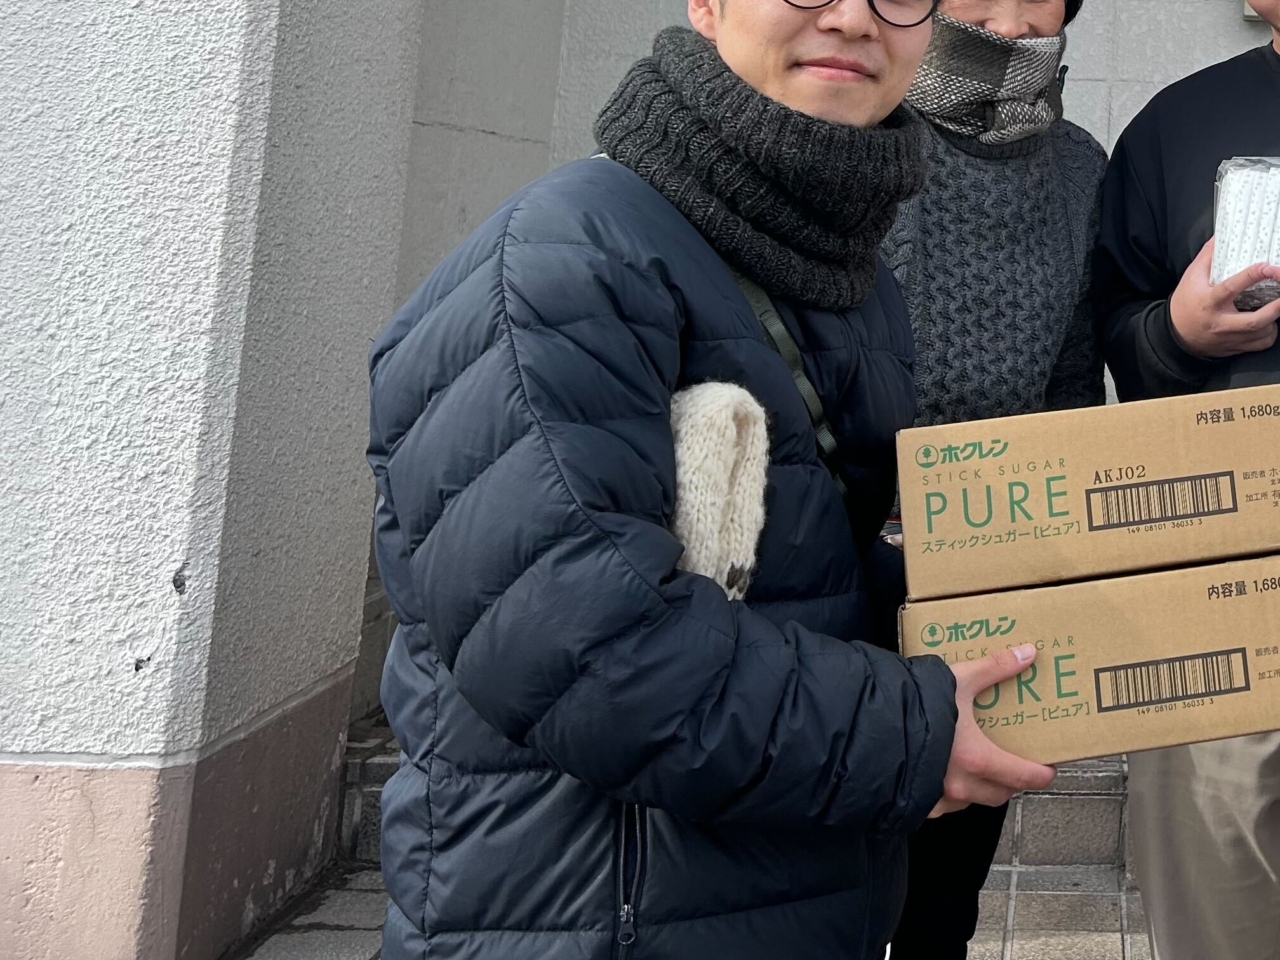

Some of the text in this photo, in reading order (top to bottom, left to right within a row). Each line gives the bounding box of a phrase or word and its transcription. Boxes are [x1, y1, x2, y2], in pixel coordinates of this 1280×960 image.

[1196, 407, 1236, 426] 内容量
[939, 439, 1009, 464] ホクレン
[922, 457, 1066, 486] STICK SUGAR
[1093, 464, 1146, 485] AKJ02
[1242, 470, 1267, 481] 販売者
[925, 475, 1070, 534] PURE
[1245, 491, 1269, 503] 加工所
[921, 520, 1081, 554] スティックシュガー[ピュア]
[1127, 518, 1203, 535] 149 08101 36033 3
[1207, 580, 1248, 600] 内容量
[946, 616, 1016, 643] ホクレン
[942, 635, 1075, 664] TICK SGAR
[1255, 646, 1279, 657] 販売者
[973, 653, 1079, 711] URE
[1136, 697, 1214, 716] 149 08101 36033 3
